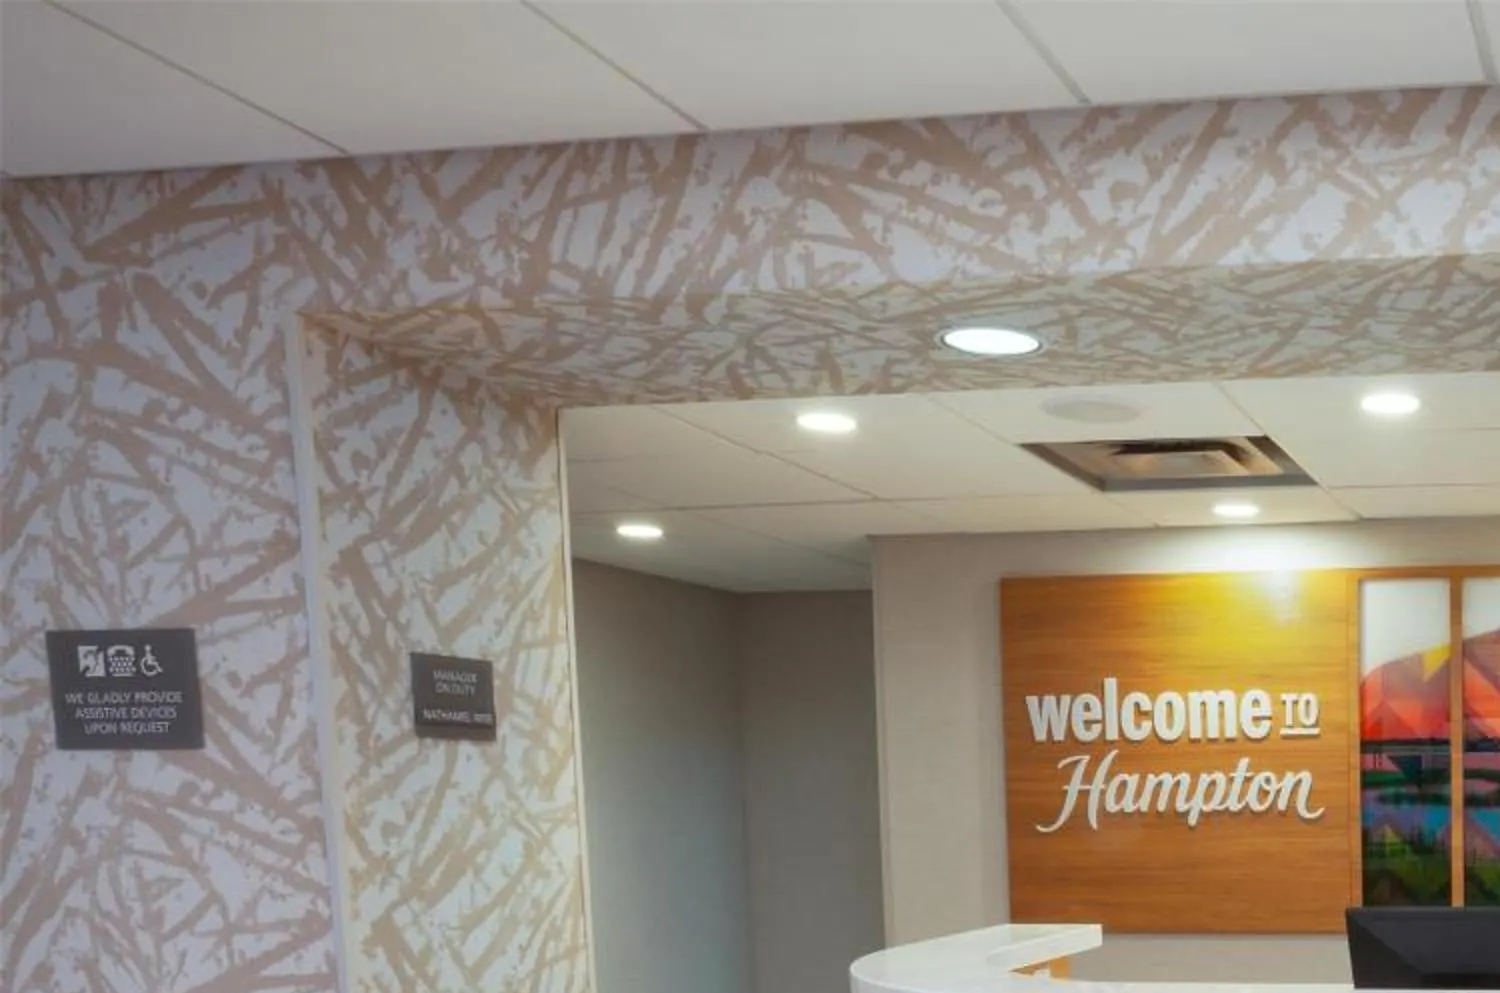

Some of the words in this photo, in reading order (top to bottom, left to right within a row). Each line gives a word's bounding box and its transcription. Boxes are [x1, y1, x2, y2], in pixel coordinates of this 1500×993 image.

[65, 693, 84, 705] WE
[87, 692, 132, 705] GLADLY
[134, 691, 183, 704] PROVIDE
[75, 707, 128, 720] ASSISTIVE
[131, 705, 177, 719] DEVICES
[1026, 677, 1272, 742] welcome
[1280, 692, 1320, 727] TO
[84, 722, 117, 735] UPON
[120, 721, 170, 735] REQUEST
[1035, 749, 1325, 833] Hampton
